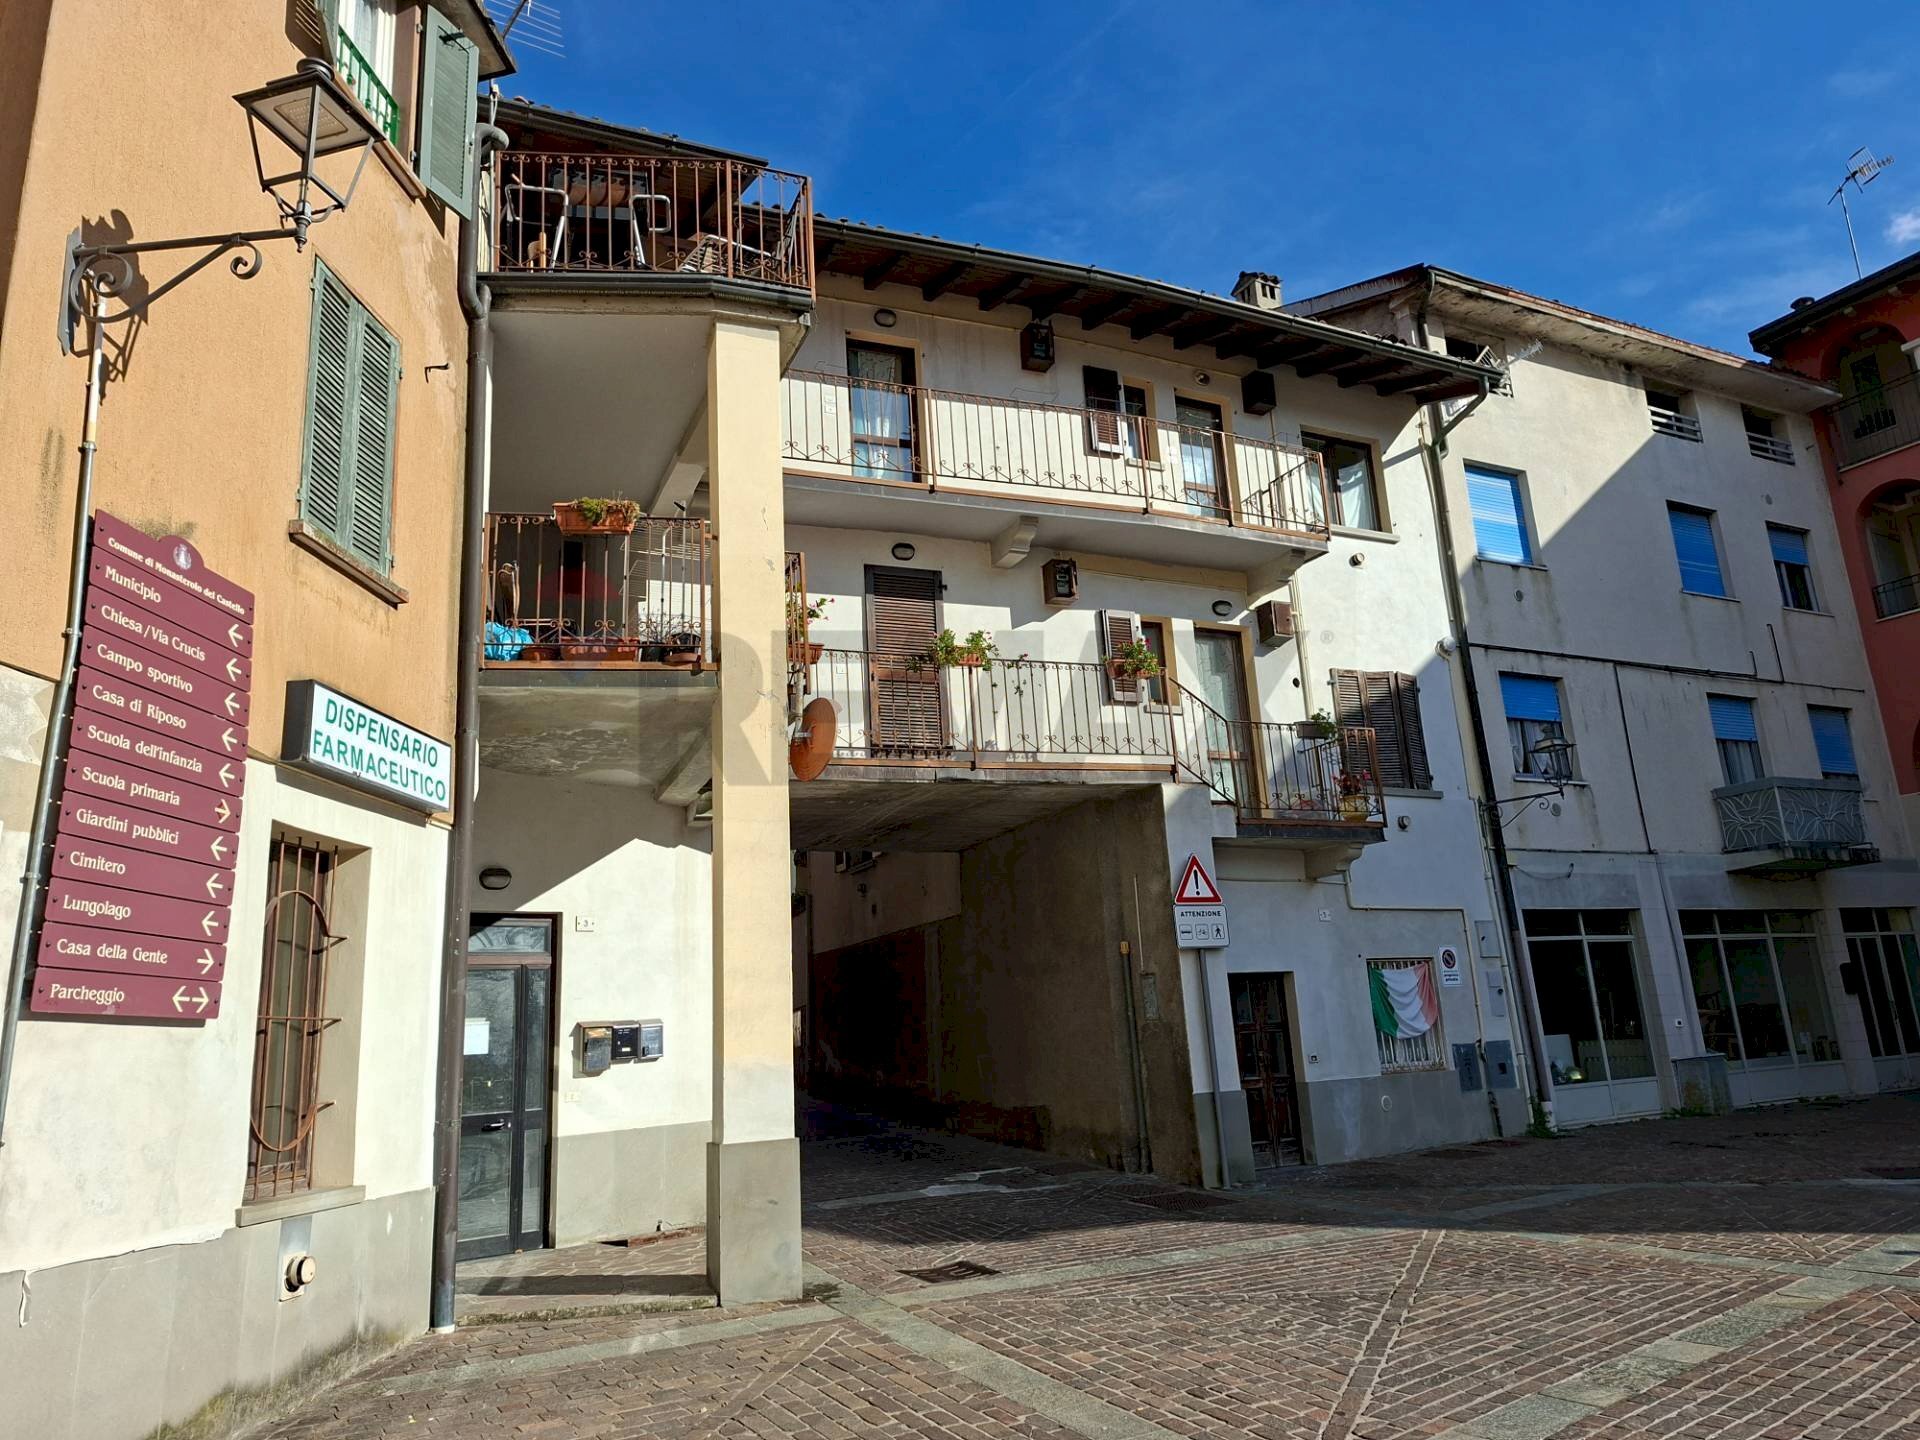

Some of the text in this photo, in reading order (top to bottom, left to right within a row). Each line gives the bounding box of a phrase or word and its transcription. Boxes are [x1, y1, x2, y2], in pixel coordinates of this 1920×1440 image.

[105, 565, 161, 603] Municipio
[108, 537, 245, 615] Comune di Monasterolo del Castello
[172, 636, 206, 661] Crucis
[97, 644, 193, 693] Campo sportivo
[92, 685, 187, 729] Casa di Riposo
[87, 725, 203, 773] Scuola dell'infanzia
[325, 698, 438, 767] DISPENSARIO
[313, 729, 446, 801] FARMACEUTICO
[82, 767, 181, 806] Scuola primaria
[76, 808, 179, 845] Giardini pubblici
[70, 851, 126, 875] Cimitero
[63, 895, 131, 921] Lungolago
[57, 938, 168, 964] Casa della Gente
[50, 983, 125, 1004] Parcheggio
